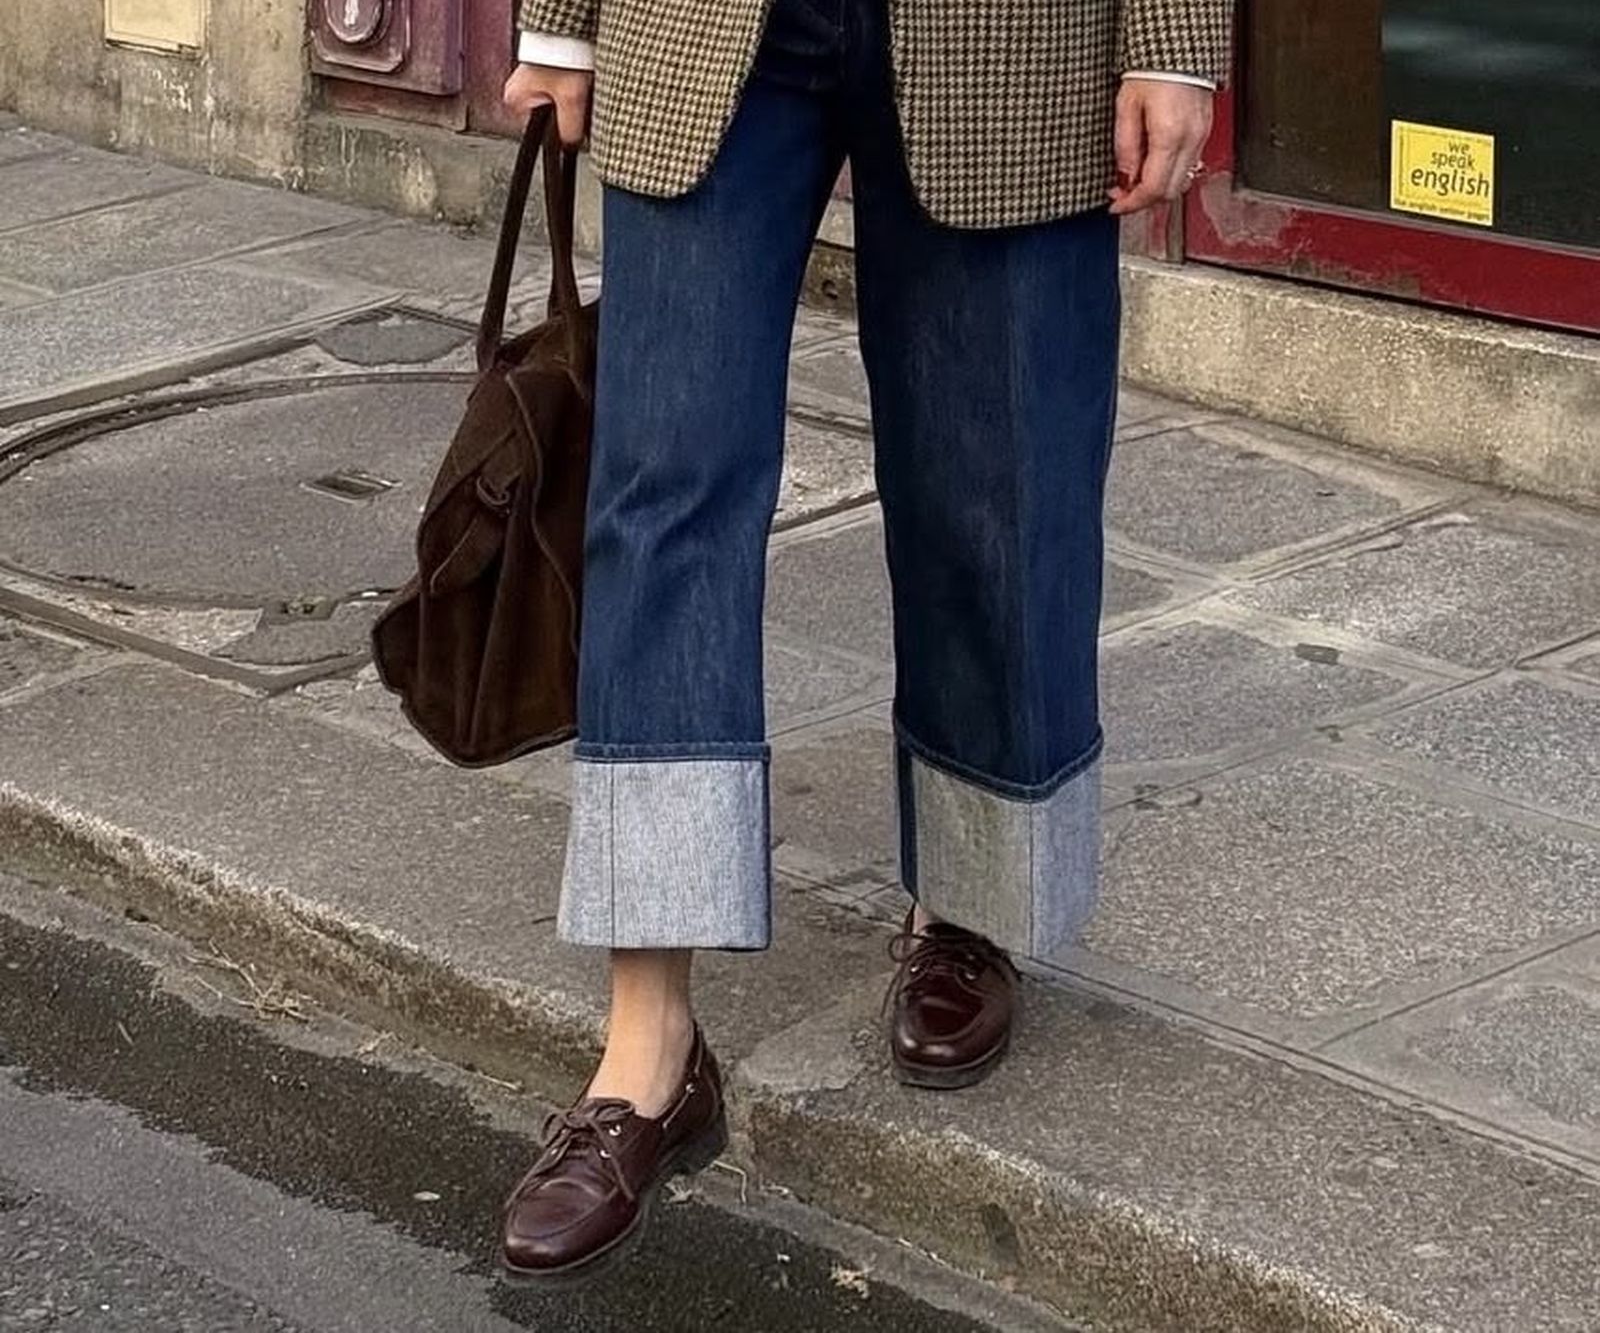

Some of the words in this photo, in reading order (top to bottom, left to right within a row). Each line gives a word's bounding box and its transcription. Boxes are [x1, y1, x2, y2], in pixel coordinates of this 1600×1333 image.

[1449, 142, 1470, 154] we
[1431, 152, 1475, 170] speak
[1411, 168, 1490, 198] english
